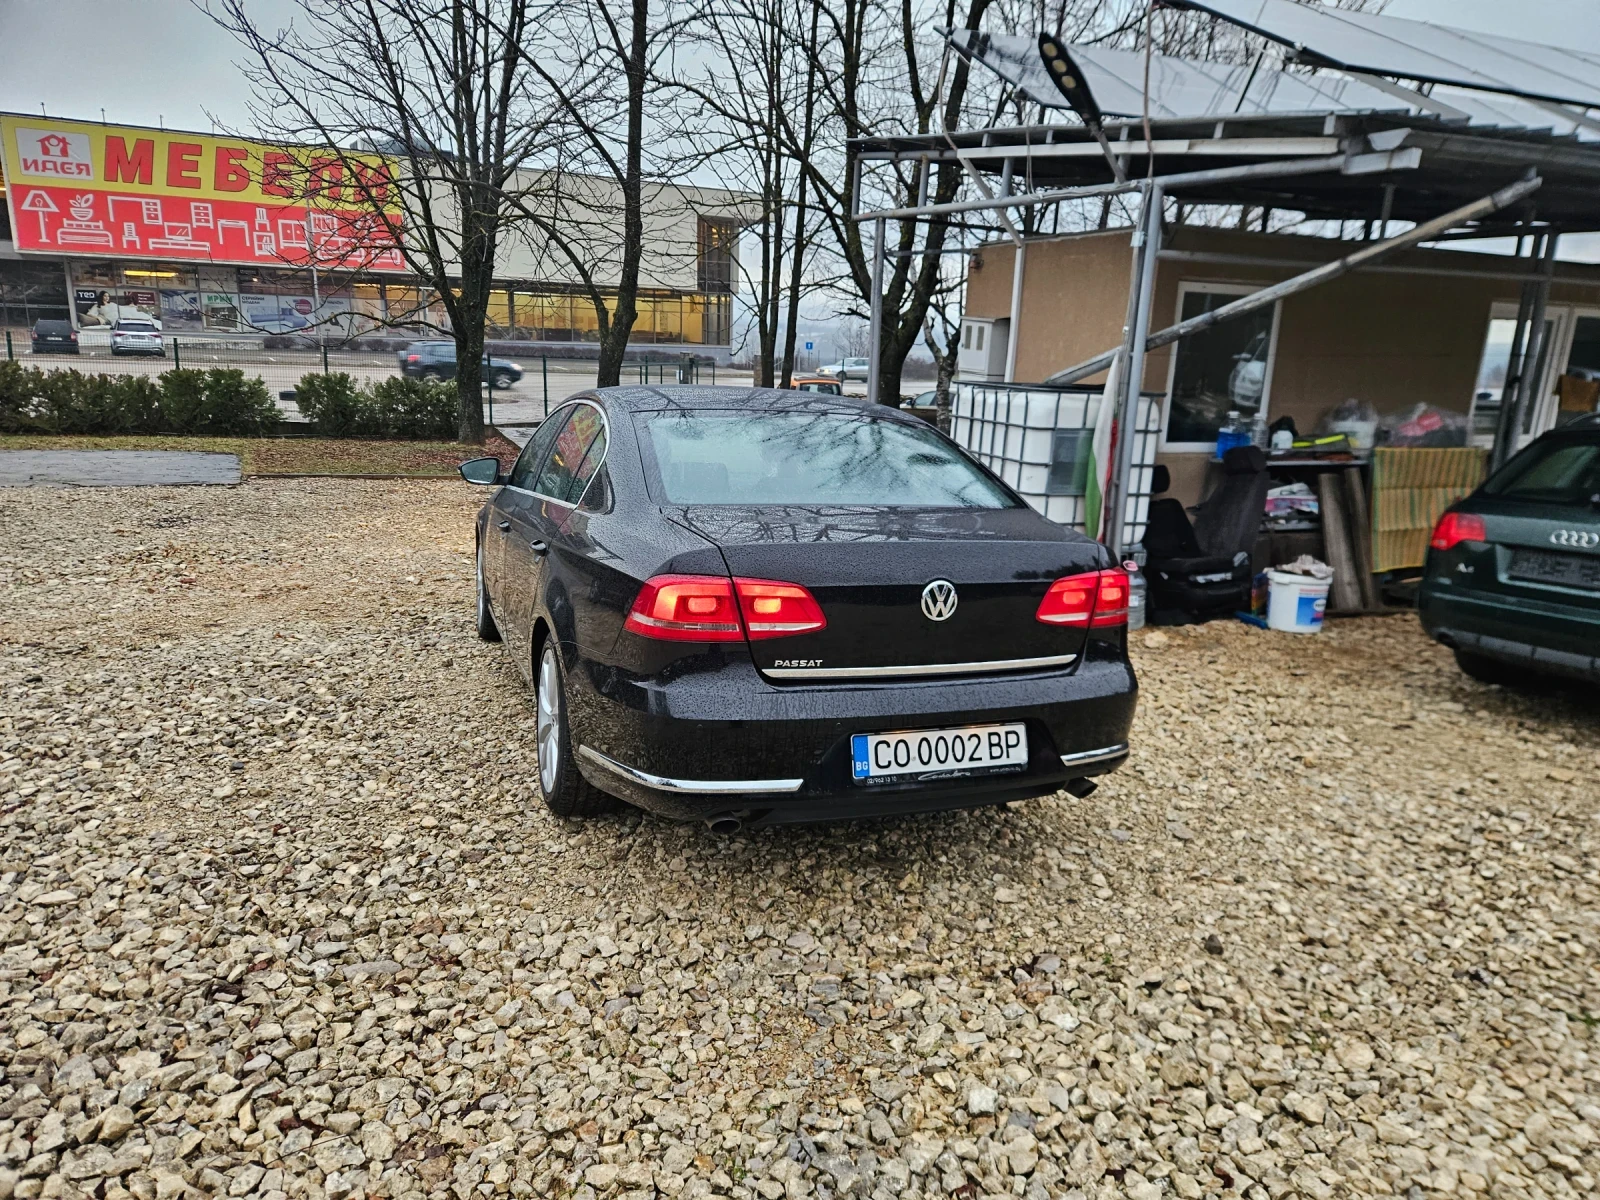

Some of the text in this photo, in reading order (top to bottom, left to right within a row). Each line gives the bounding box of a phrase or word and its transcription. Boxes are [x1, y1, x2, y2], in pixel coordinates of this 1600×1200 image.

[22, 158, 92, 177] ИДЕЯ
[104, 135, 391, 204] МЕБЕЛИ
[774, 659, 823, 668] PASSAT
[855, 761, 869, 772] BG
